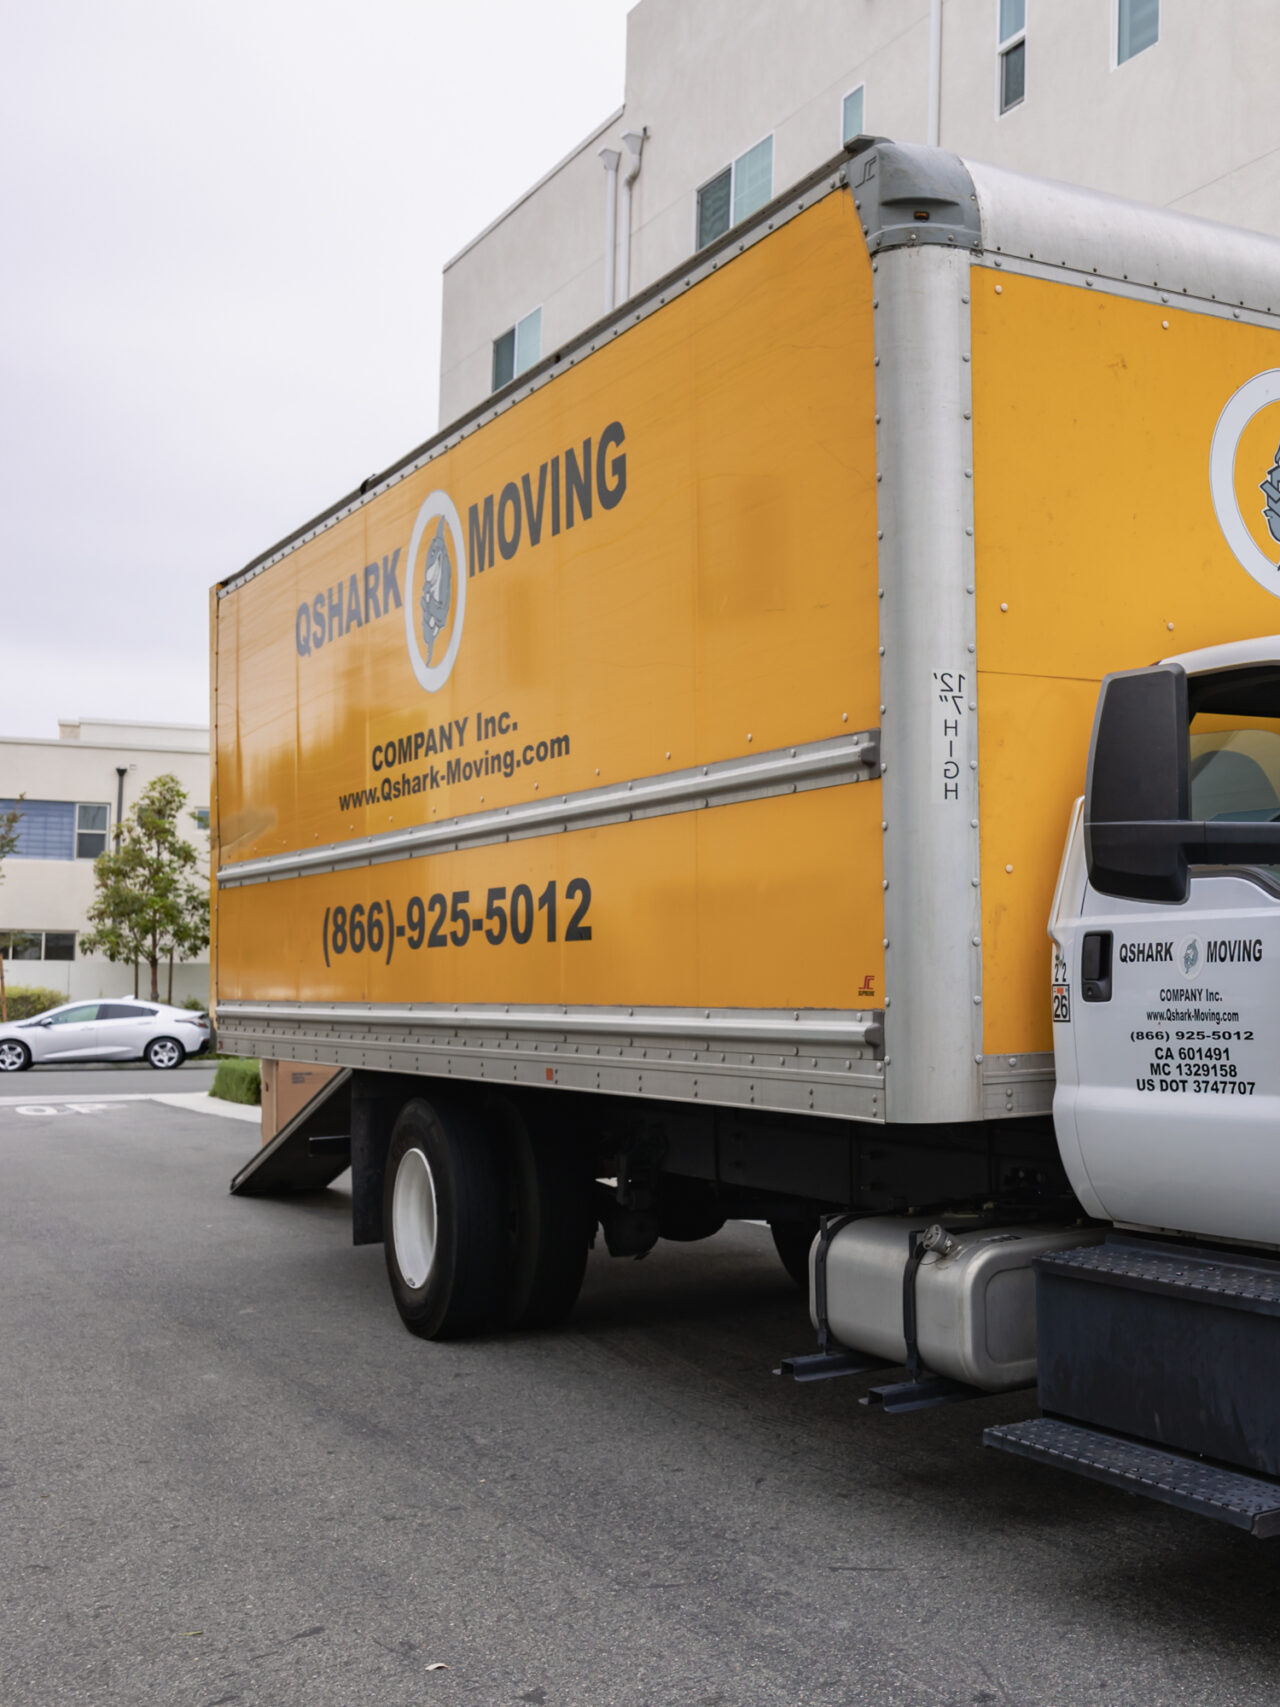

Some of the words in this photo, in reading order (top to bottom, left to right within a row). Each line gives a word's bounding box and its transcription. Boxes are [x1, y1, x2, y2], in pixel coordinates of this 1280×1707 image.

[296, 547, 402, 657] QSHARK
[468, 421, 626, 578] MOVING
[372, 717, 469, 771] COMPANY
[477, 712, 518, 741] Inc.
[339, 735, 570, 811] www.Qshark-Moving.com
[323, 877, 592, 967] (866)-925-5012
[1119, 942, 1174, 963] QSHARK
[1206, 939, 1263, 963] MOVING
[1160, 988, 1203, 1002] COMPANY
[1206, 988, 1223, 1002] Inc.
[1053, 995, 1068, 1019] 26
[1146, 1008, 1240, 1025] www.Qshark-Moving.com
[1130, 1031, 1170, 1042] (866)
[1175, 1031, 1254, 1041] 925-5012
[1155, 1047, 1175, 1060] CA
[1178, 1047, 1230, 1061] 601491
[1150, 1063, 1171, 1076] MC
[1176, 1063, 1237, 1077] 1329158
[1136, 1079, 1155, 1091] US
[1160, 1079, 1188, 1092] DOT
[1193, 1080, 1256, 1095] 3747707
